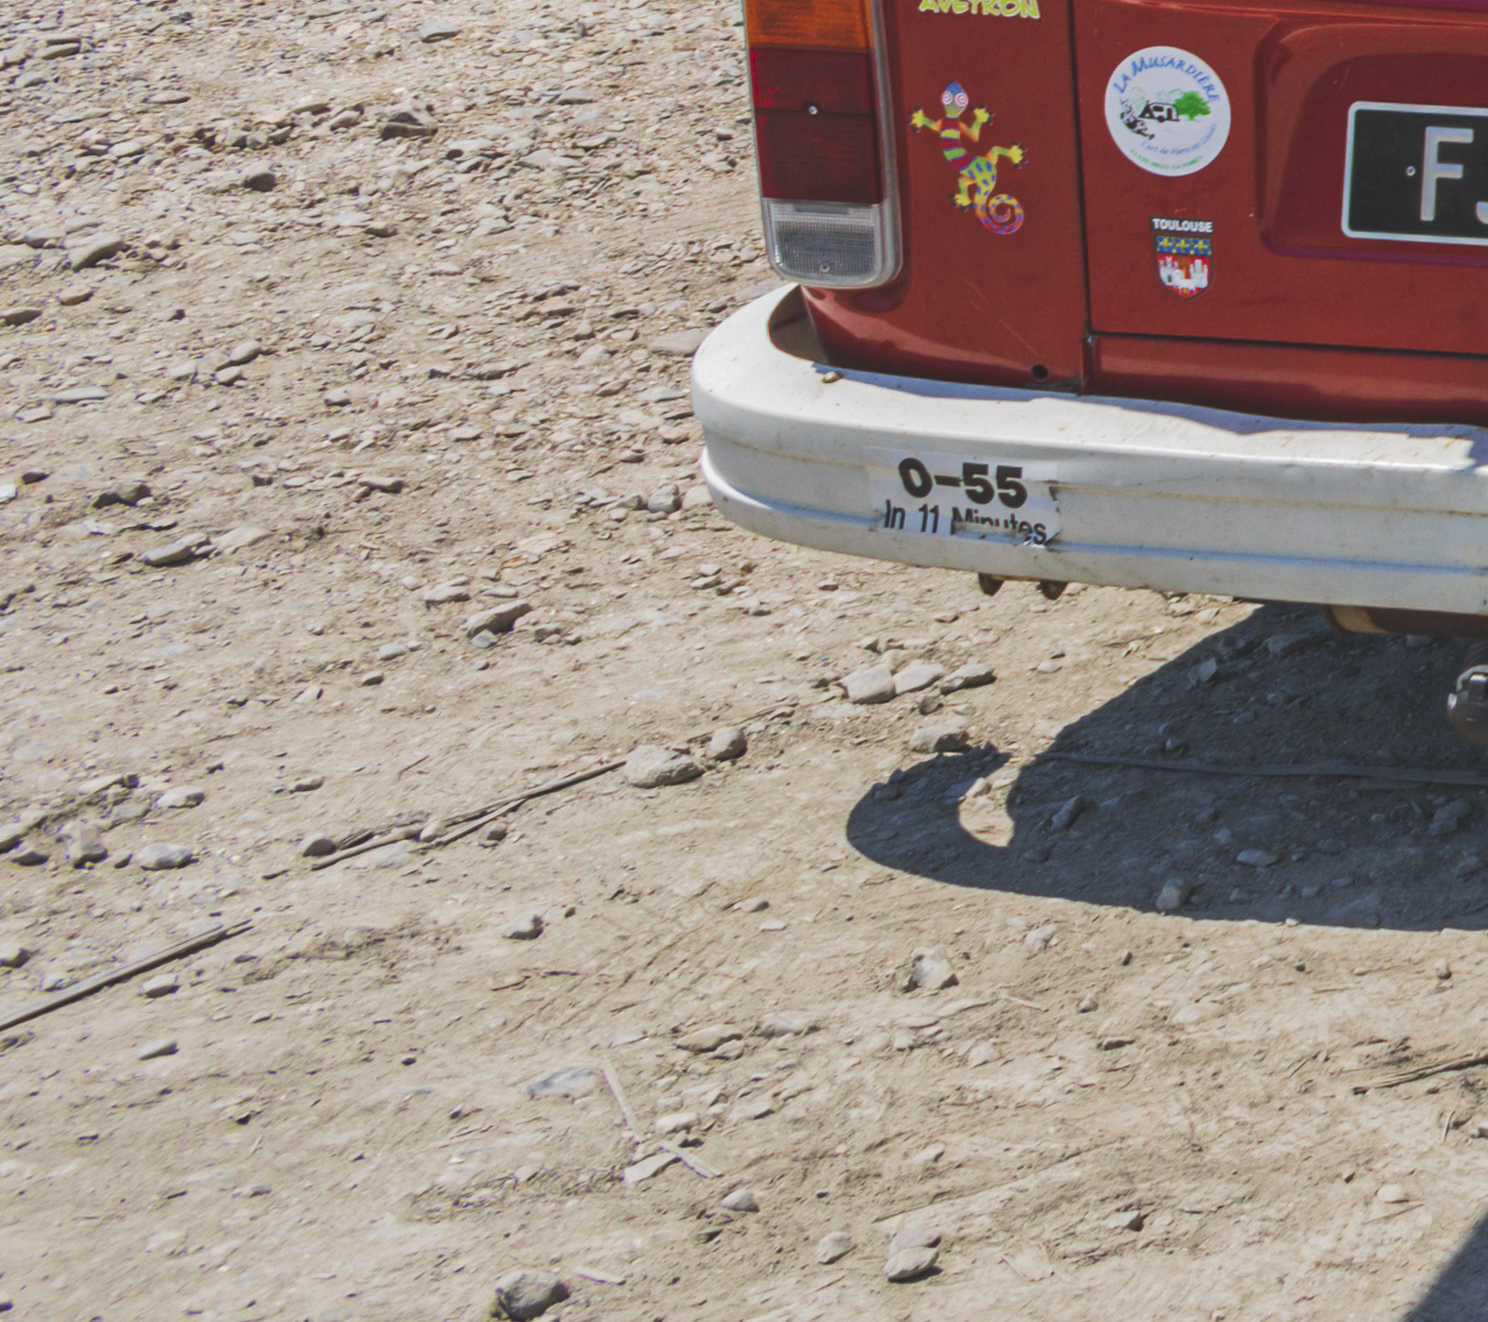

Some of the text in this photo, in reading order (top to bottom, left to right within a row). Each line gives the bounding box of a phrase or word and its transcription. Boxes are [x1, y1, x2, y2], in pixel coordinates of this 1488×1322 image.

[1152, 218, 1213, 233] TOULOUSE
[897, 457, 1028, 509] 0-55
[883, 498, 907, 531] In
[918, 503, 940, 534] 11
